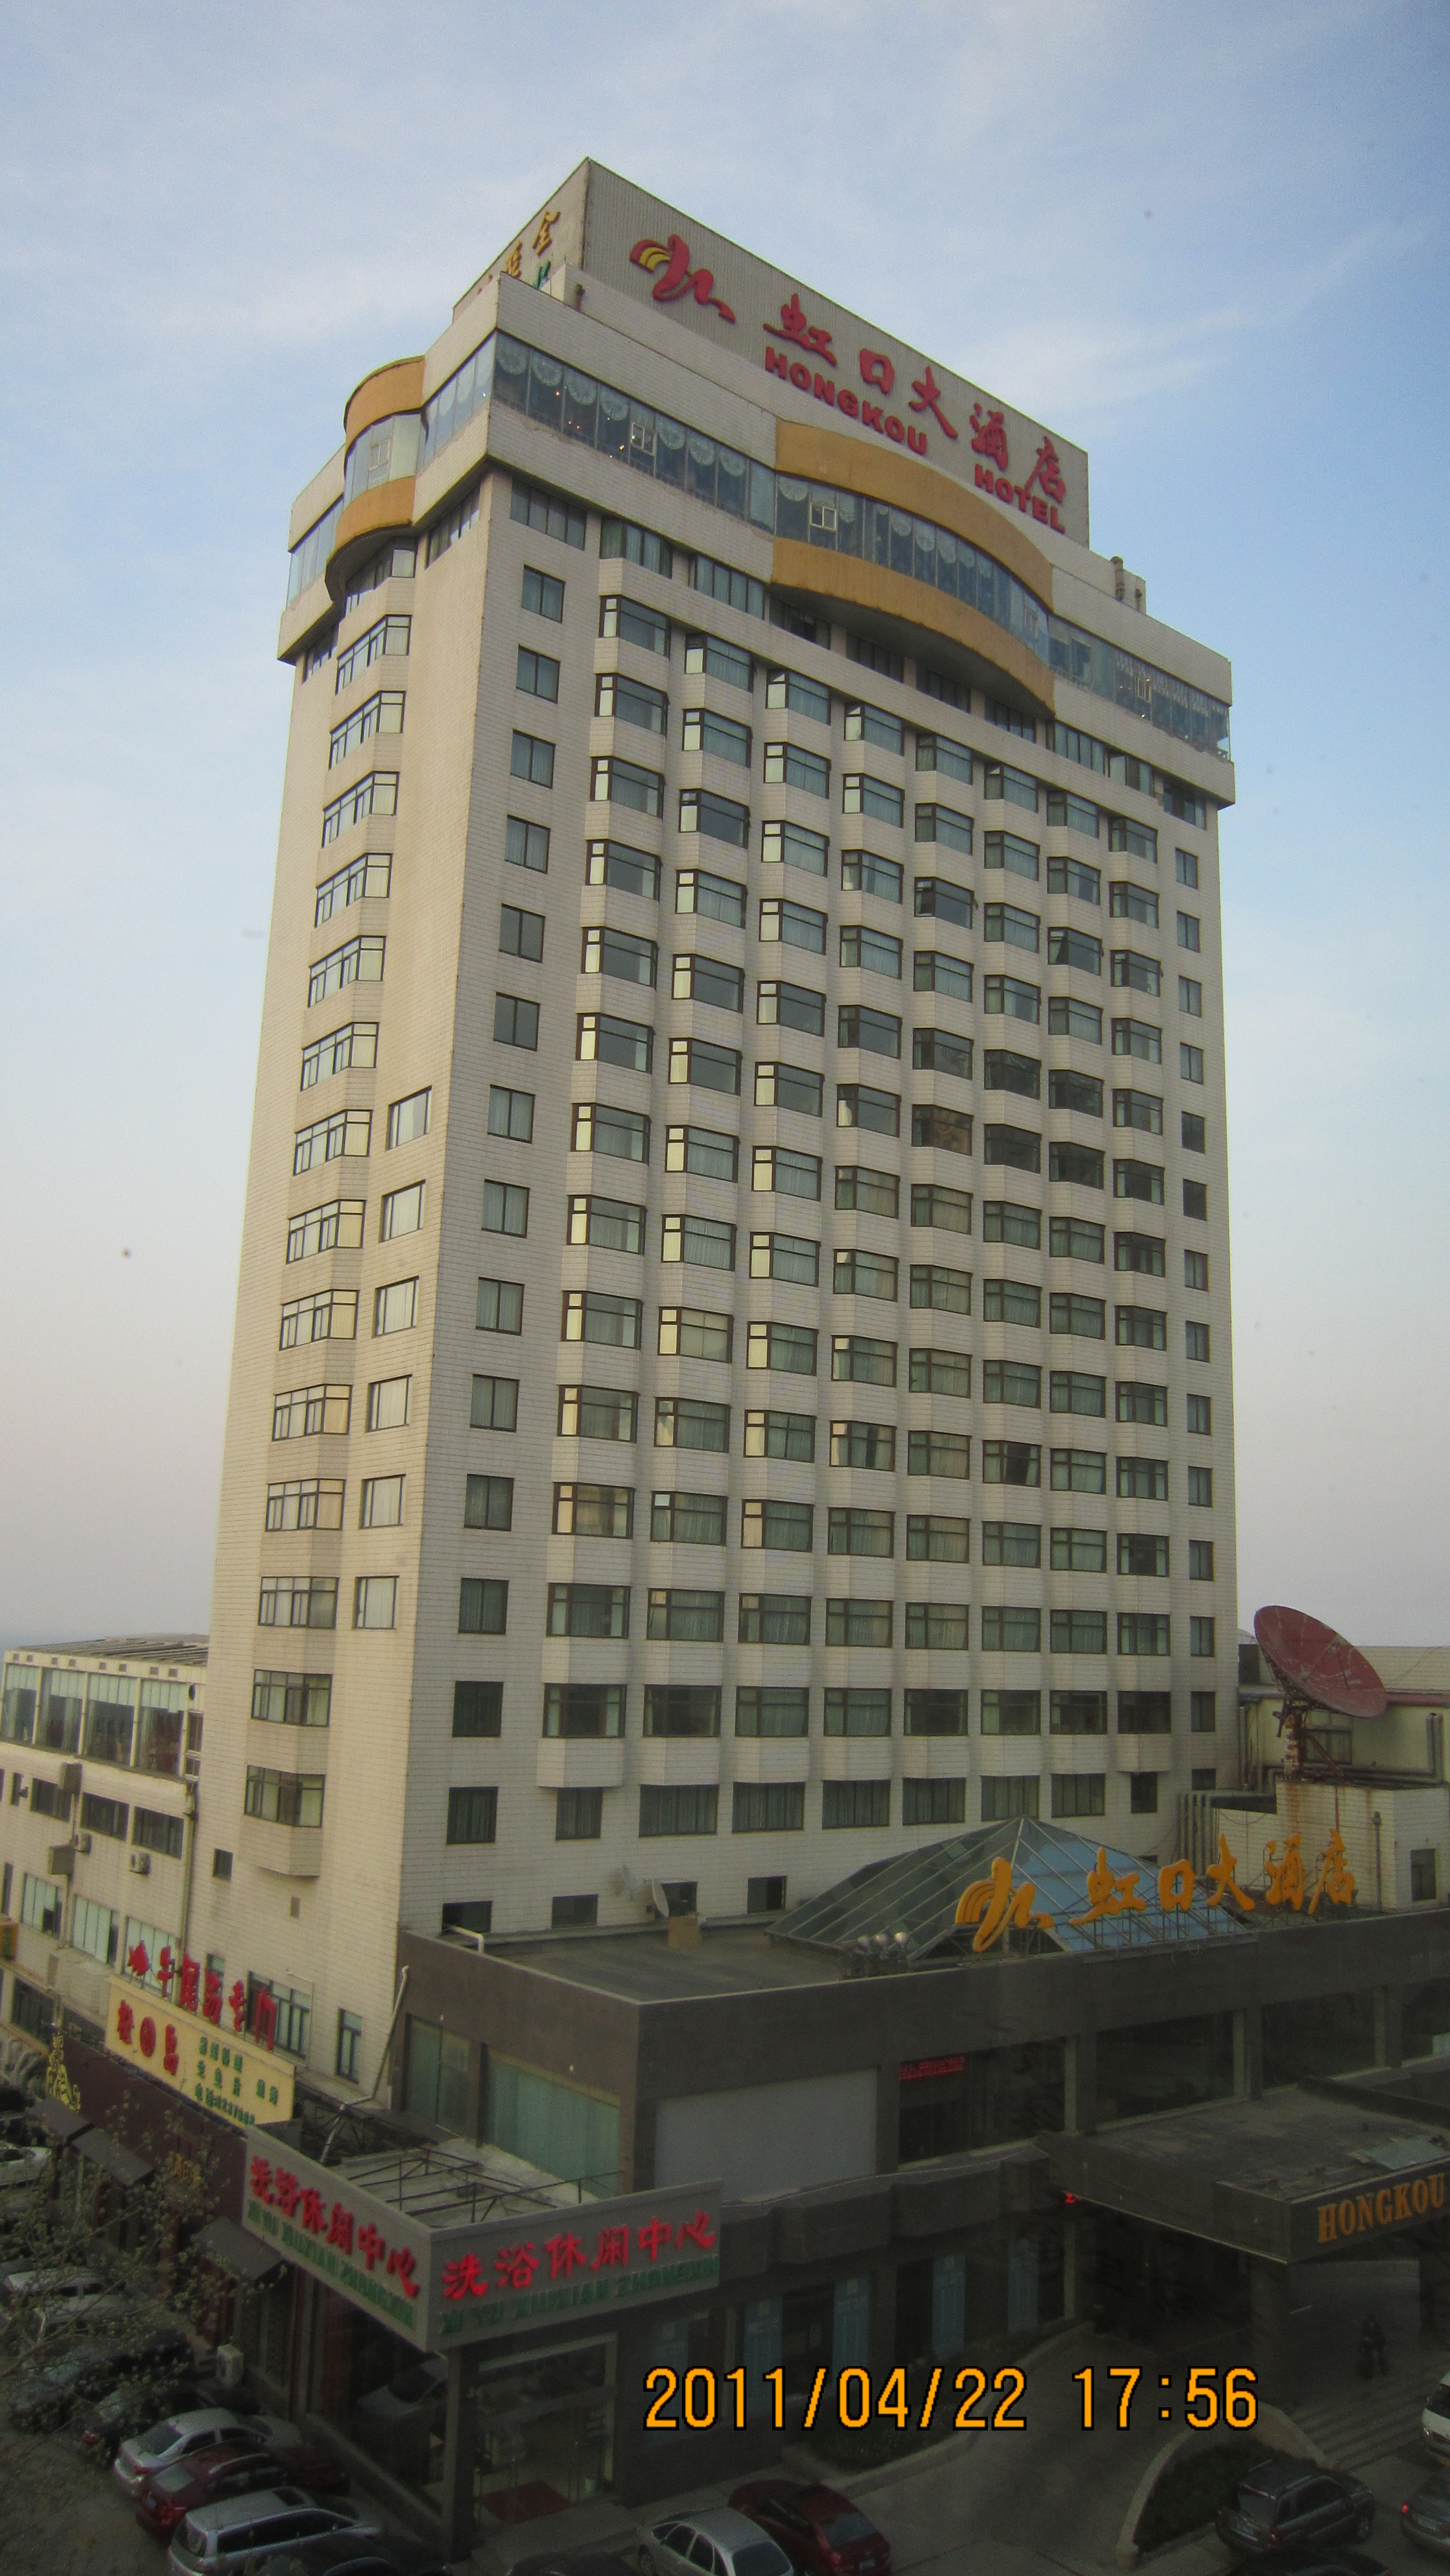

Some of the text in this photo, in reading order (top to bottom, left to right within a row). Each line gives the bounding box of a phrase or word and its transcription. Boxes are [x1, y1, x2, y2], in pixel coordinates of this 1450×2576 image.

[763, 292, 1066, 504] 虹口大酒店
[764, 346, 1065, 534] HONGKOU HOTEL
[1070, 1828, 1357, 1925] 虹口大酒店
[249, 2155, 420, 2298] 洗浴休闲中心
[442, 2210, 715, 2300] 洗浴休闲中心
[1317, 2172, 1445, 2244] HONGKOU
